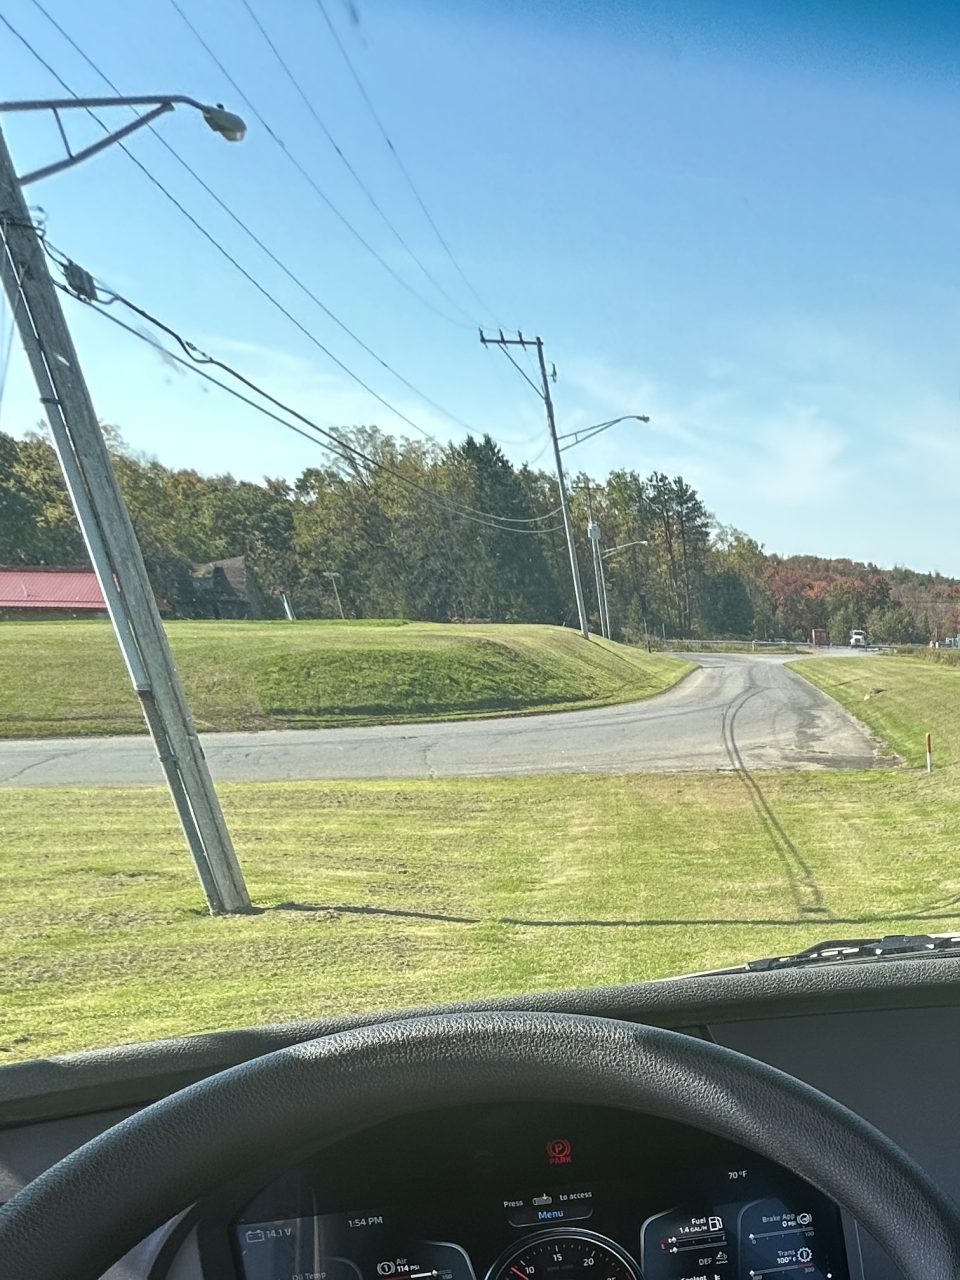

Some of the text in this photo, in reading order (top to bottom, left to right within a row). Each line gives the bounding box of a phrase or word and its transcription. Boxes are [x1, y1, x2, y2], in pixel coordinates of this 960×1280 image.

[503, 1200, 523, 1208] Press
[569, 1192, 593, 1200] access
[538, 1210, 564, 1219] Menu
[348, 1216, 383, 1228] 1:54 PM
[691, 1217, 706, 1225] Fuel
[762, 1215, 780, 1223] Brake
[266, 1228, 292, 1238] 14.1 V
[553, 1254, 563, 1262] 15
[583, 1257, 594, 1266] 20
[699, 1258, 712, 1266] DEF
[525, 1266, 535, 1274] 10
[292, 1272, 327, 1280] Oil Temp
